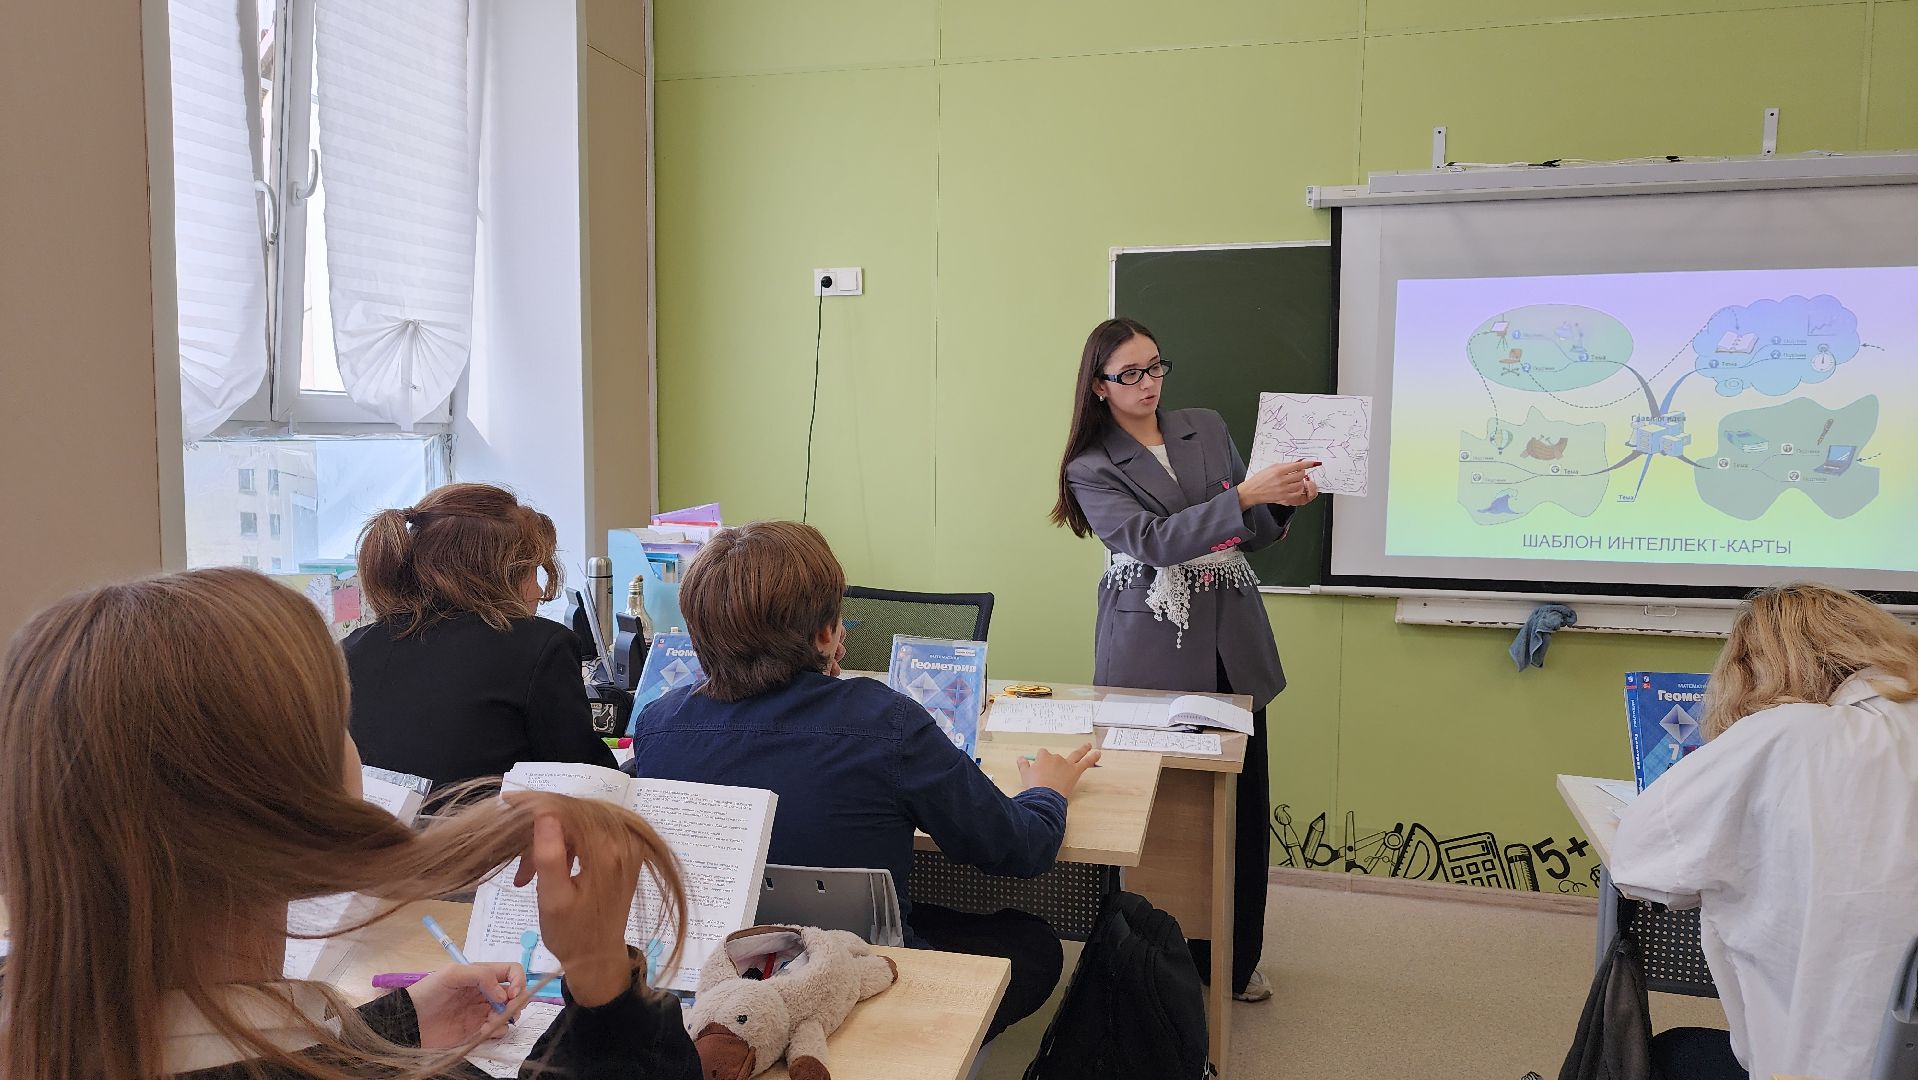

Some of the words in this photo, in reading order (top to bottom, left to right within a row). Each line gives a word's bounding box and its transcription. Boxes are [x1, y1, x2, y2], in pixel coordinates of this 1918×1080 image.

[1523, 533, 1602, 549] ШАБЛОН
[1607, 536, 1791, 554] ИНТЕЛЛЕКТ-КАРТЫ
[911, 658, 977, 674] Геометрия
[1532, 836, 1590, 880] 5+
